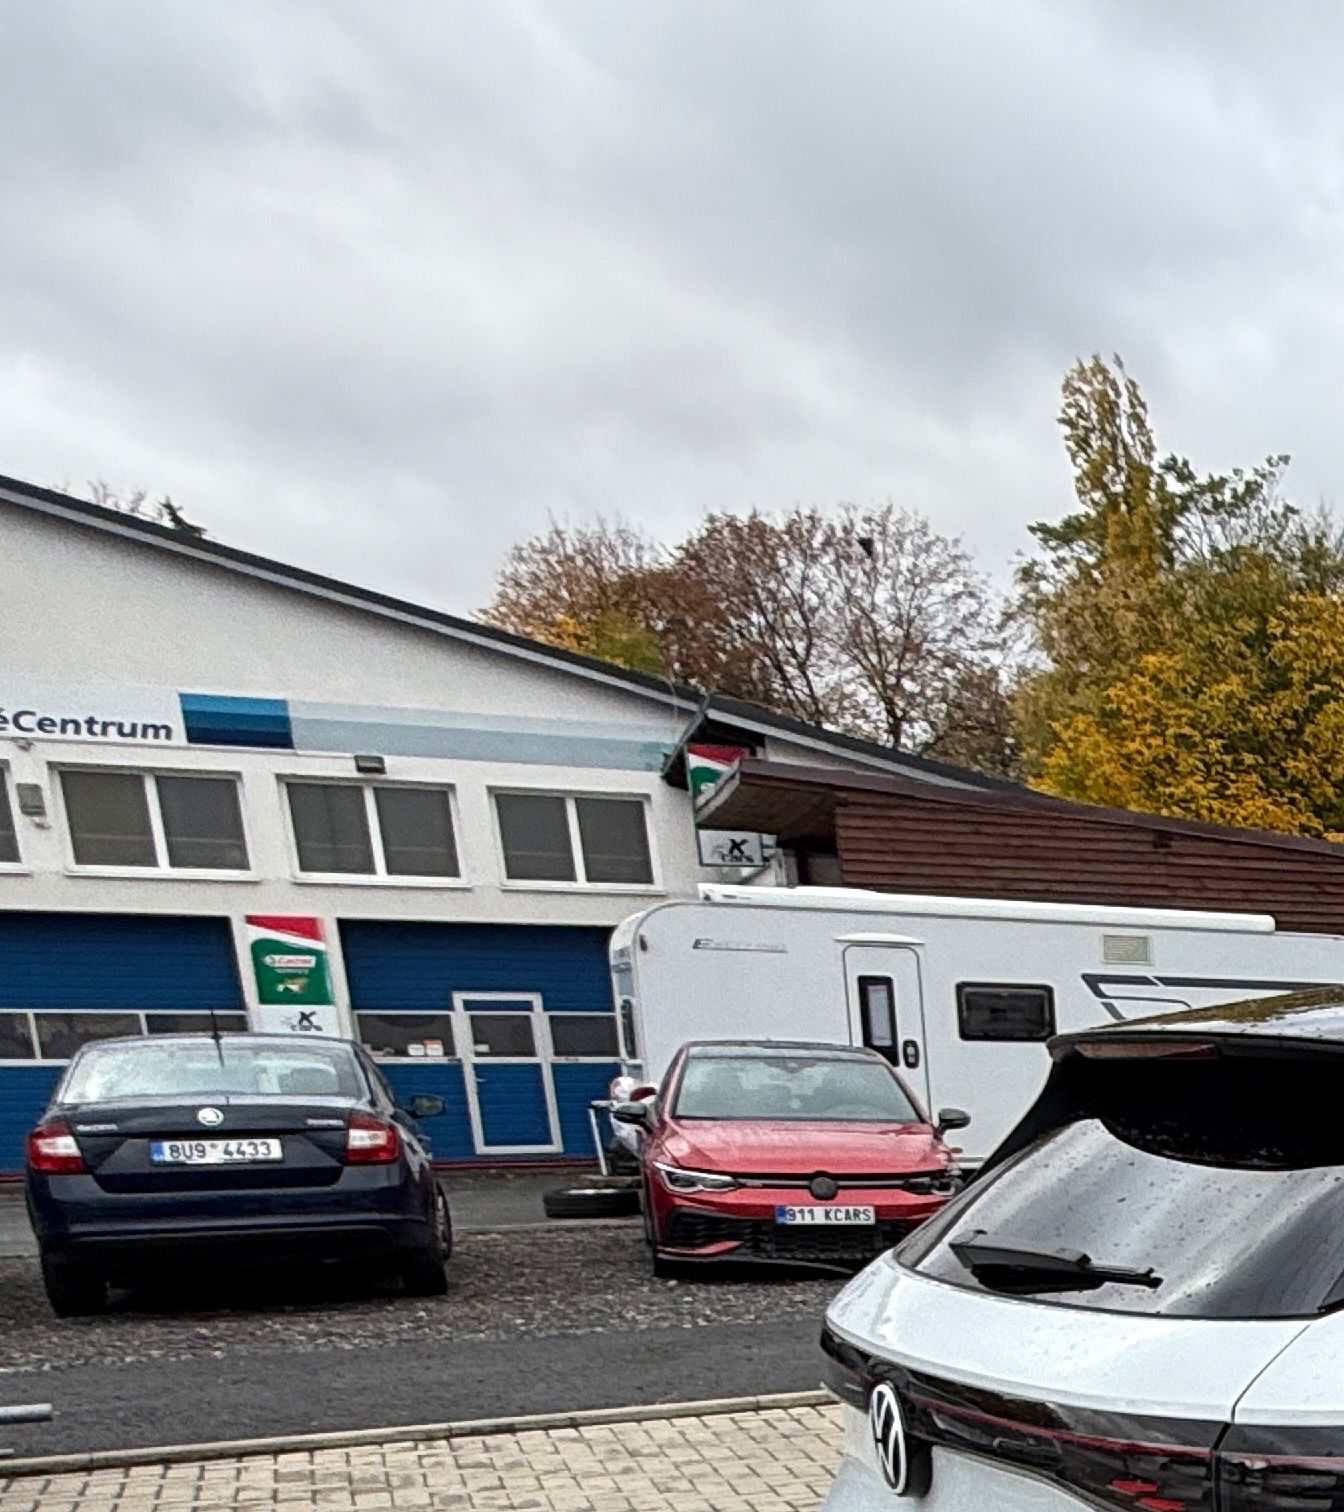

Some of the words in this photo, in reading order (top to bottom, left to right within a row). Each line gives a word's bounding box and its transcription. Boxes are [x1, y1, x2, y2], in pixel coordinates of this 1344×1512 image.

[169, 1142, 206, 1160] 8U9
[223, 1141, 272, 1158] 4433
[787, 1208, 816, 1221] 911
[824, 1208, 872, 1221] KCARS
